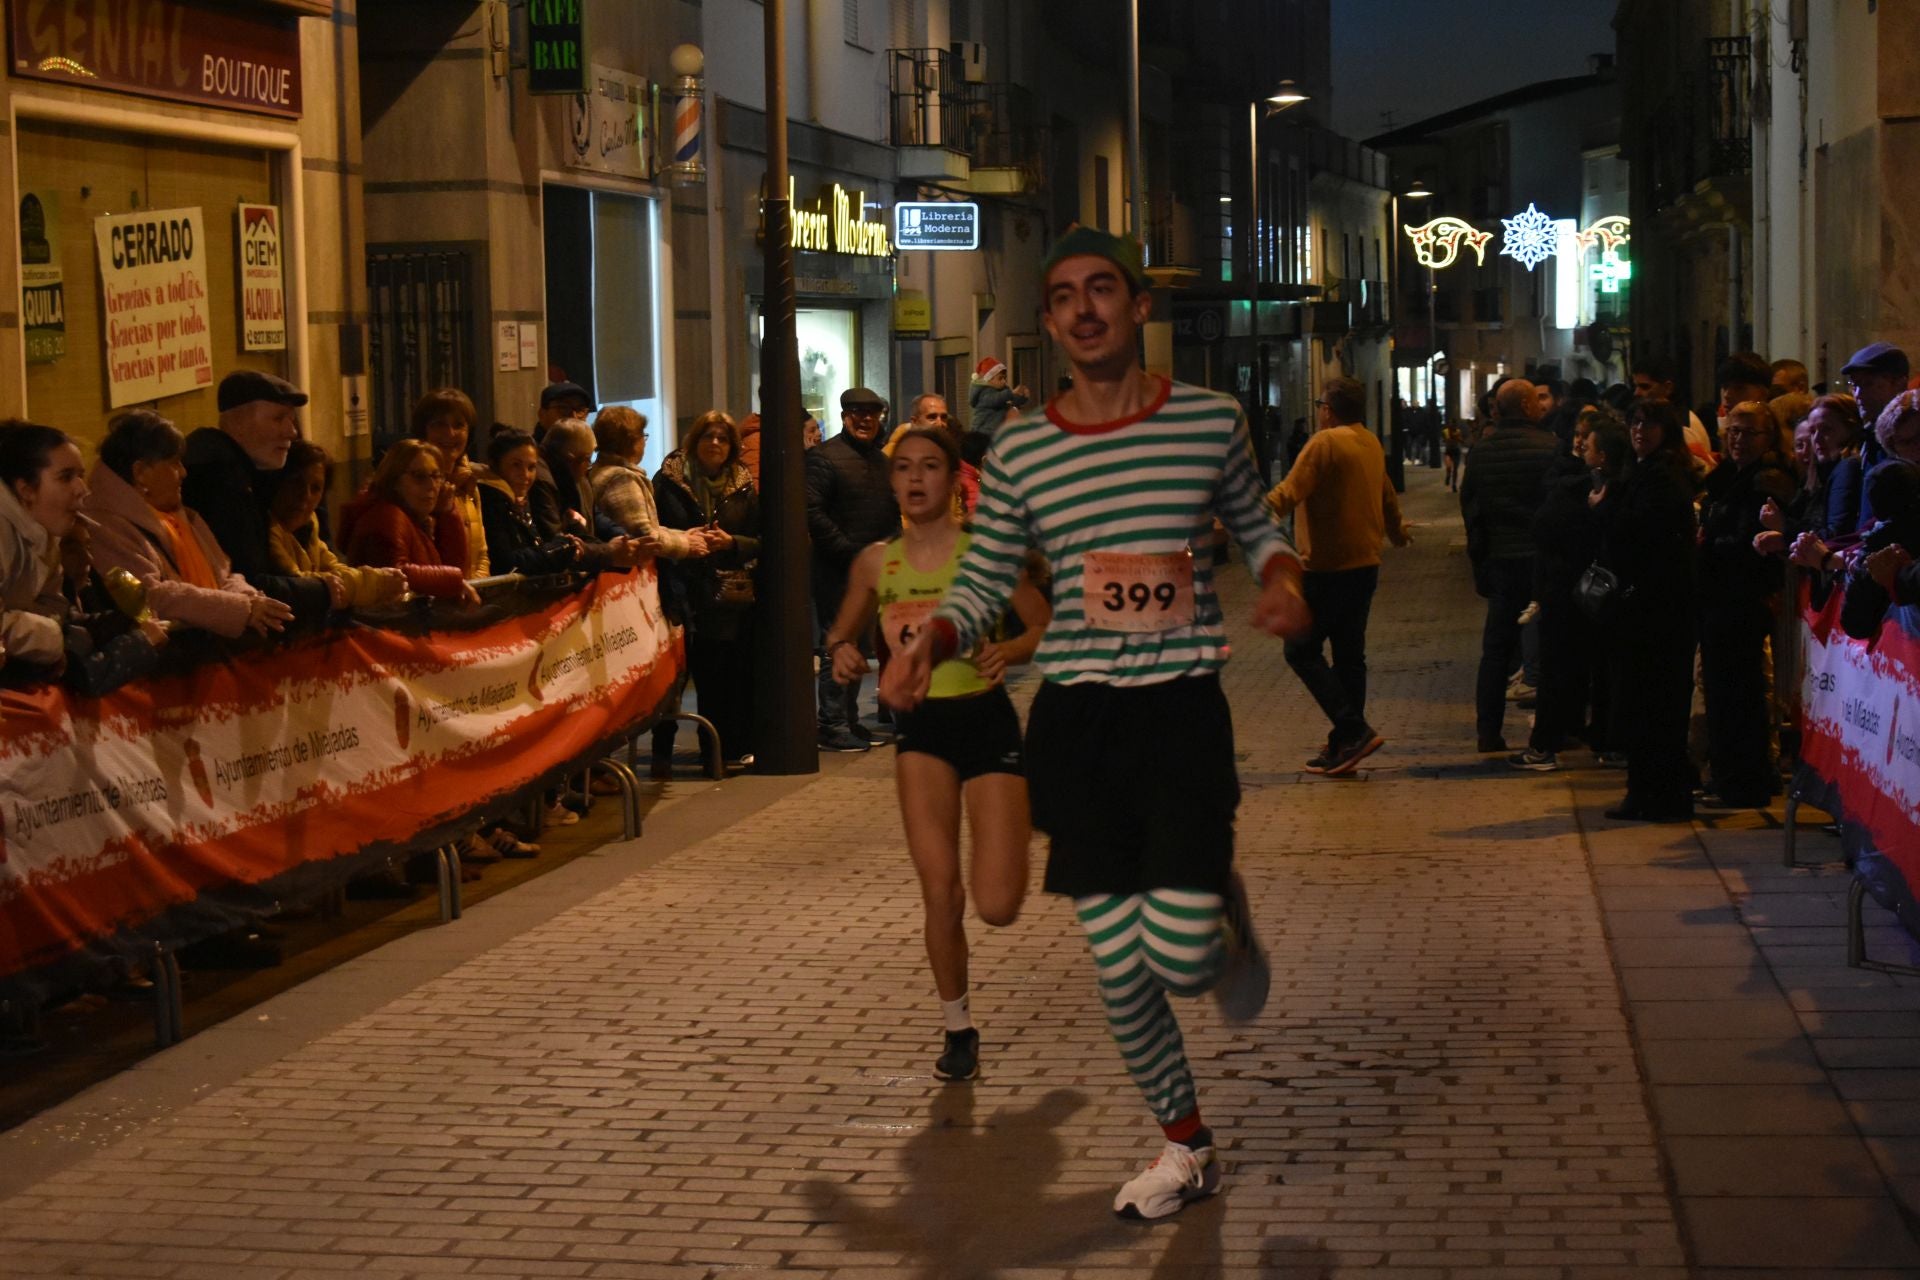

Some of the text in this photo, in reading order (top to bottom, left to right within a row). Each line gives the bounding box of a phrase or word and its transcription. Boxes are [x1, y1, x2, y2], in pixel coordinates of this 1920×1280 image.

[534, 40, 577, 70] BAR
[202, 54, 291, 105] BOUTIQUE
[834, 183, 888, 257] Moderna
[921, 211, 973, 221] Librería
[924, 224, 971, 233] Moderna
[111, 217, 193, 270] CERRADO
[245, 240, 278, 266] CIEM
[106, 279, 152, 314] Gracias
[156, 285, 165, 305] a
[245, 288, 283, 320] ALQUILA
[110, 315, 153, 350] Gracias
[156, 318, 177, 349] por
[111, 348, 156, 383] Gracias
[157, 352, 176, 384] por
[1103, 581, 1176, 612] 399
[214, 723, 360, 791] Ayuntamiento de Miajadas
